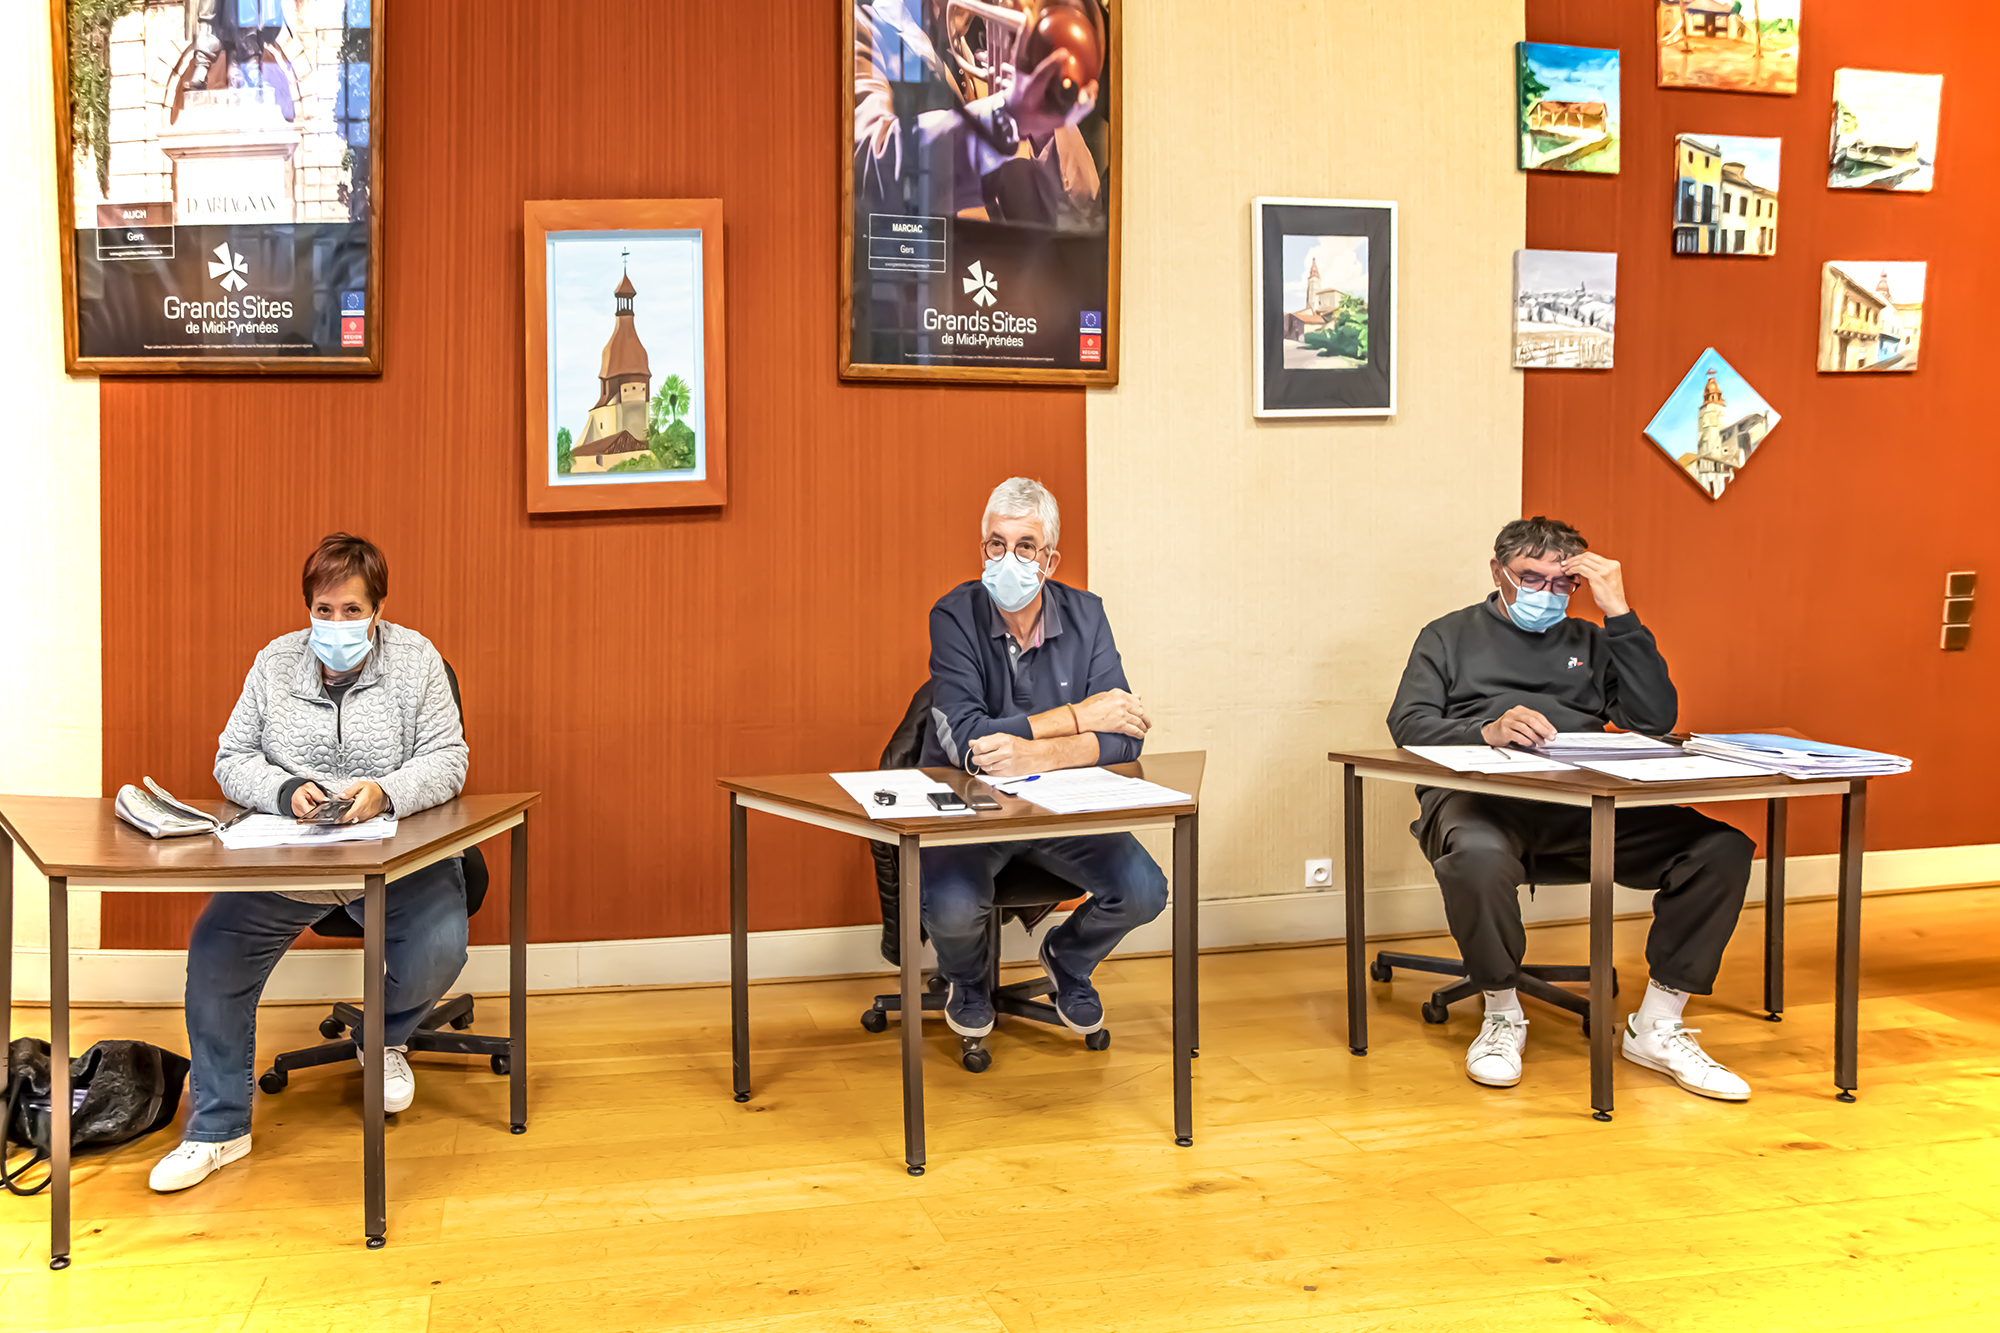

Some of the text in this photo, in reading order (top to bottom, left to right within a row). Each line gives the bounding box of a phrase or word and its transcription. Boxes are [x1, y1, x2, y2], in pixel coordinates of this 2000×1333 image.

[122, 210, 147, 220] AUCH
[892, 223, 923, 234] MARCIAC
[127, 232, 145, 242] Gers
[900, 244, 915, 254] Gers
[163, 295, 293, 319] Grands Sites
[923, 308, 1038, 333] Grands Sites
[185, 320, 279, 337] de Midi-Pyrénées
[941, 333, 1024, 349] de Midi-Pyrénées
